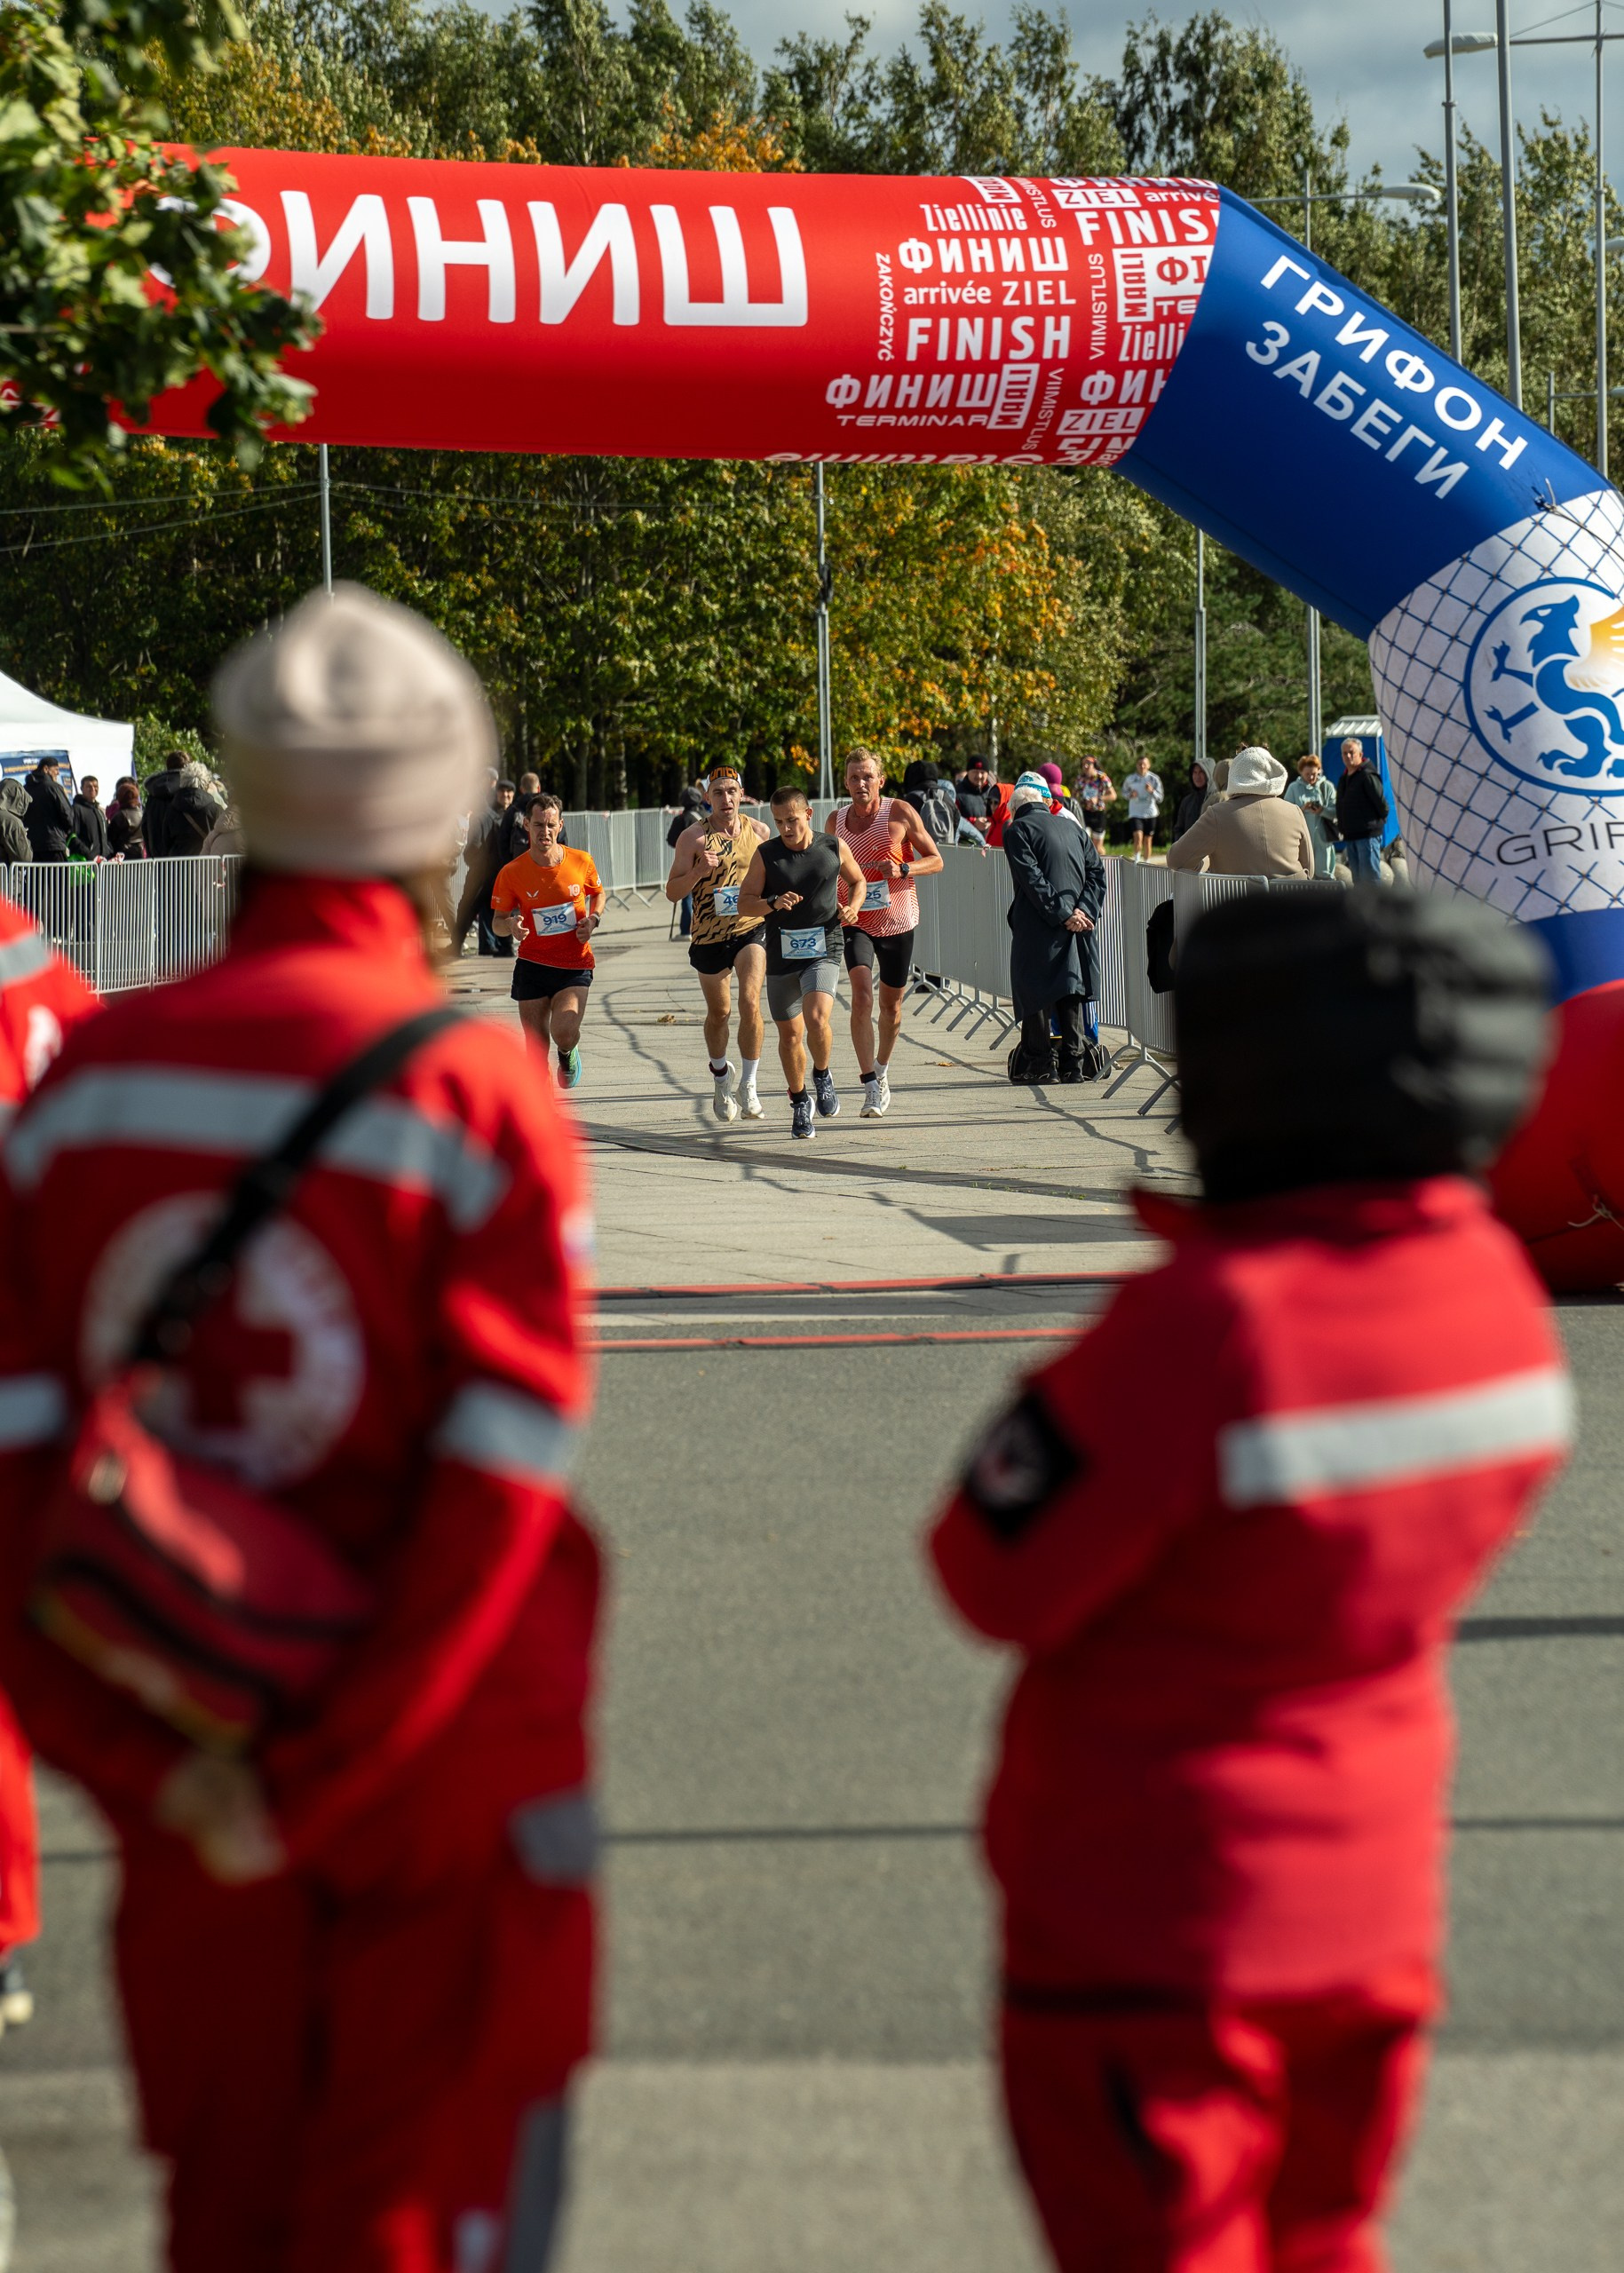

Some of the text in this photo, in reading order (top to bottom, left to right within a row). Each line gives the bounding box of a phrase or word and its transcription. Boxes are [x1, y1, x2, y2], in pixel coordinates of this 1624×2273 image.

[1058, 191, 1137, 204] ZIEL
[1145, 189, 1220, 203] arrivé
[919, 203, 1028, 232] Ziellinie
[898, 237, 1069, 274] ФИНИШ
[875, 252, 898, 362] ZAKOŃCZYĆ
[903, 280, 1077, 306] arrivée ZIEL
[1088, 253, 1107, 360] VIIMISTLUS
[906, 315, 1071, 361] FINISH
[1260, 255, 1529, 471] ГРИФОН
[825, 374, 999, 409] ФИНИШ
[836, 414, 989, 427] TERMINAR
[1021, 368, 1066, 451] VIIMISTLUS
[1063, 410, 1138, 432] ZIEL
[1245, 320, 1470, 500] ЗАБЕГИ
[543, 914, 567, 926] 919
[790, 938, 817, 949] 673
